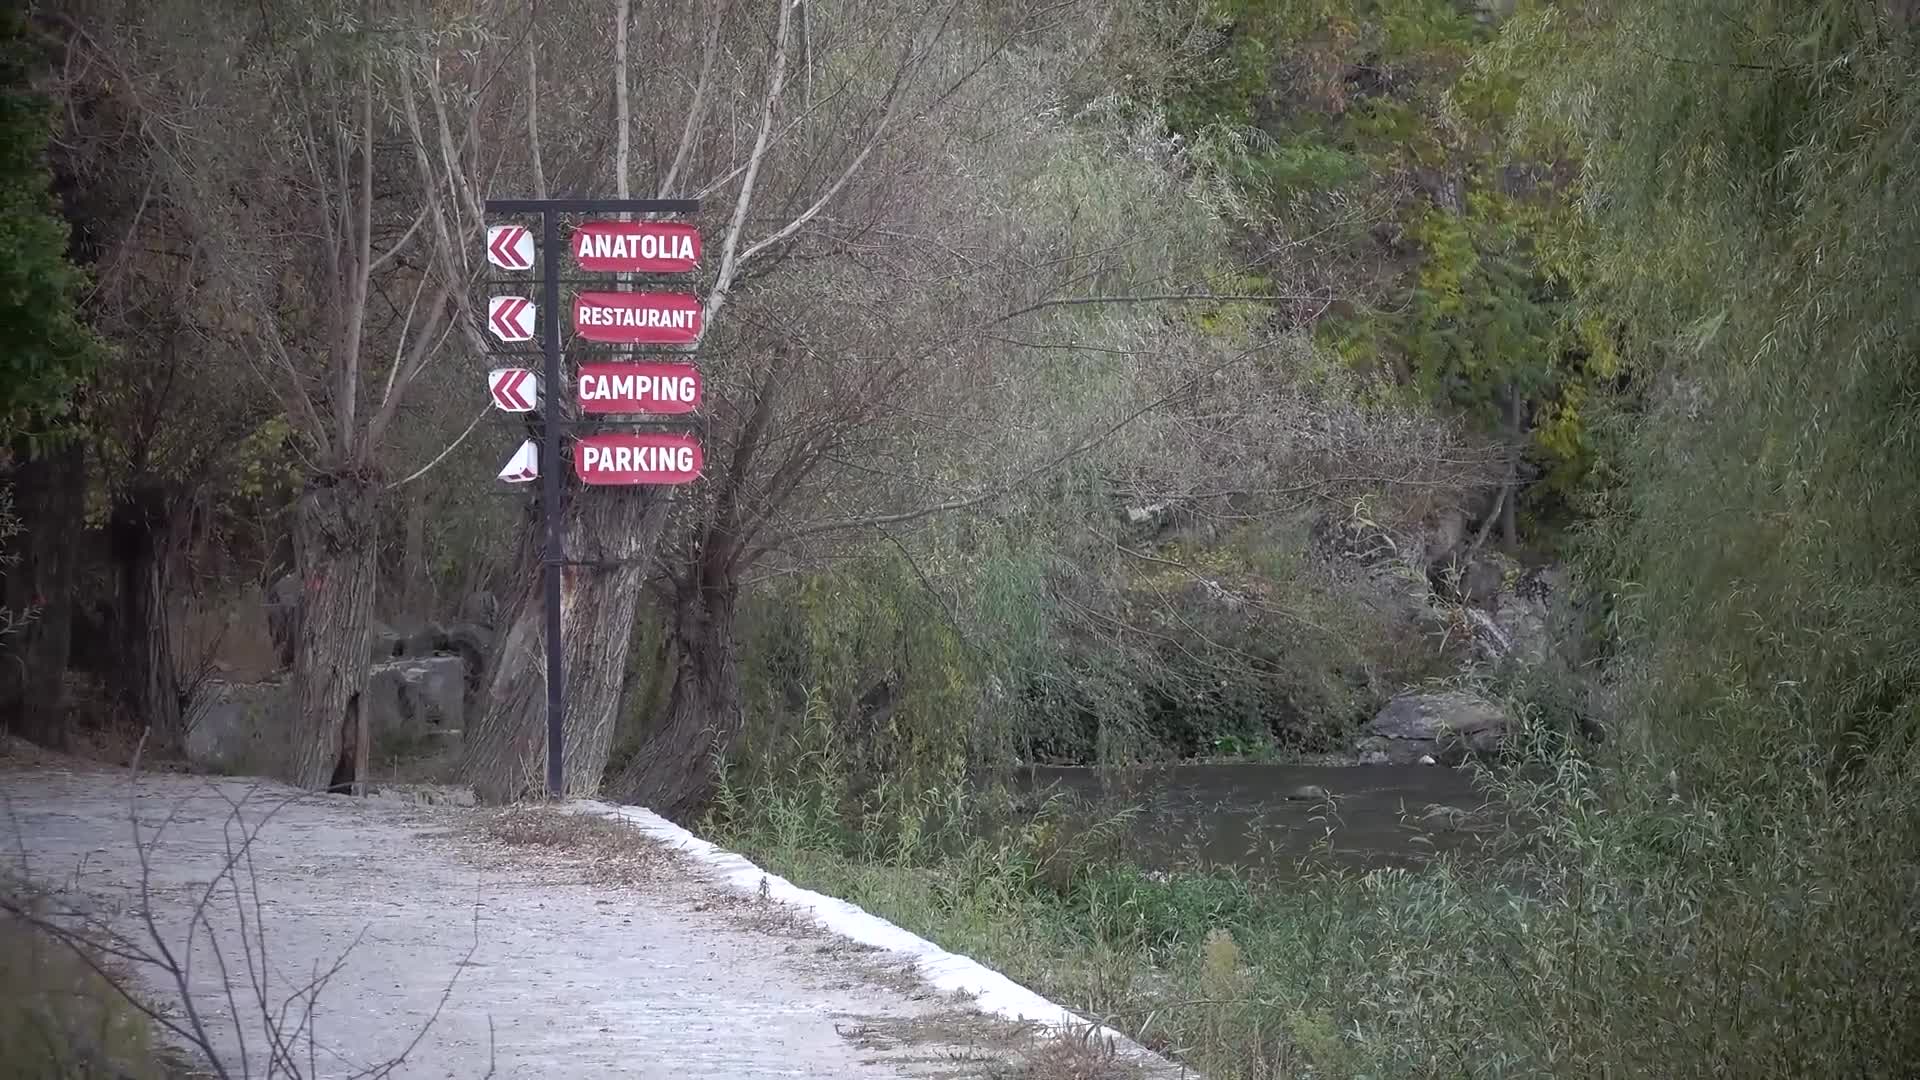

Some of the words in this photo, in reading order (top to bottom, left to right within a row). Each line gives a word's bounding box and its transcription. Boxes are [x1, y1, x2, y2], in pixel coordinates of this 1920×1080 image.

[579, 234, 694, 259] ANATOLIA
[579, 307, 697, 328] RESTAURANT
[579, 375, 696, 401] CAMPING
[583, 446, 693, 472] PARKING
